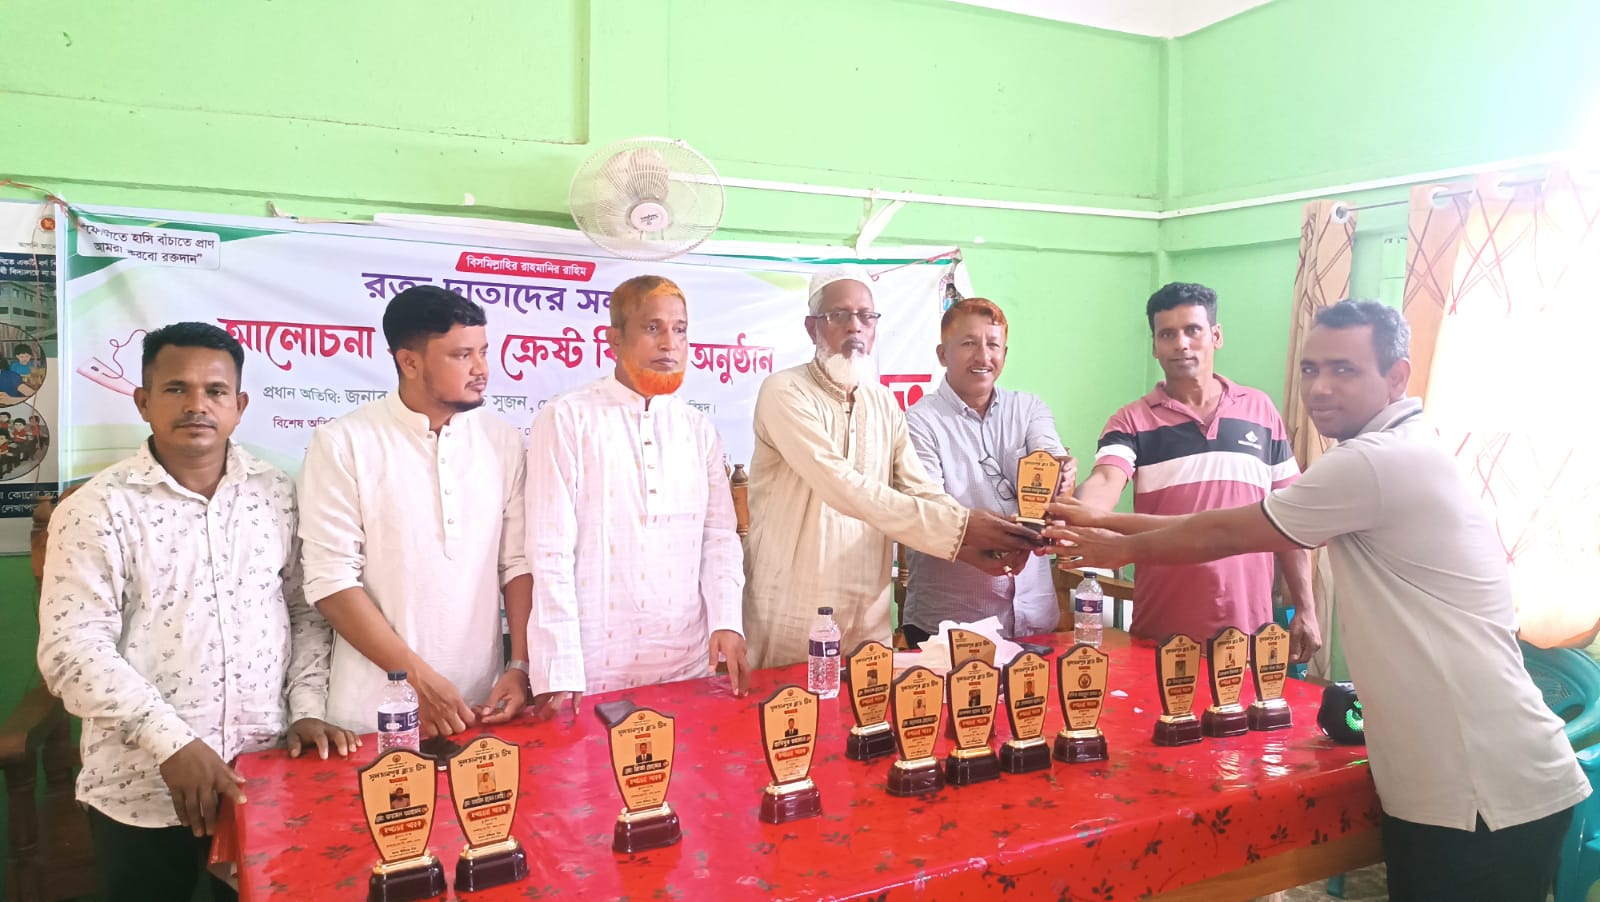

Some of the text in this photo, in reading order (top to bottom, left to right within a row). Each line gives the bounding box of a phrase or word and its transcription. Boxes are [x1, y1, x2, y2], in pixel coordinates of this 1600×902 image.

[131, 232, 153, 244] হাসি
[157, 233, 192, 247] বাঁচাতে
[195, 238, 215, 249] প্রাণ
[466, 255, 587, 277] বিসমিল্লাহির রাহমানির রাহিম
[216, 318, 376, 371] আলোচনা
[501, 327, 586, 381] ক্রেষ্ট
[689, 332, 775, 385] অনুষ্ঠান
[263, 385, 295, 400] প্রধান
[300, 388, 341, 404] অতিথি:
[273, 415, 304, 429] বিশেষ
